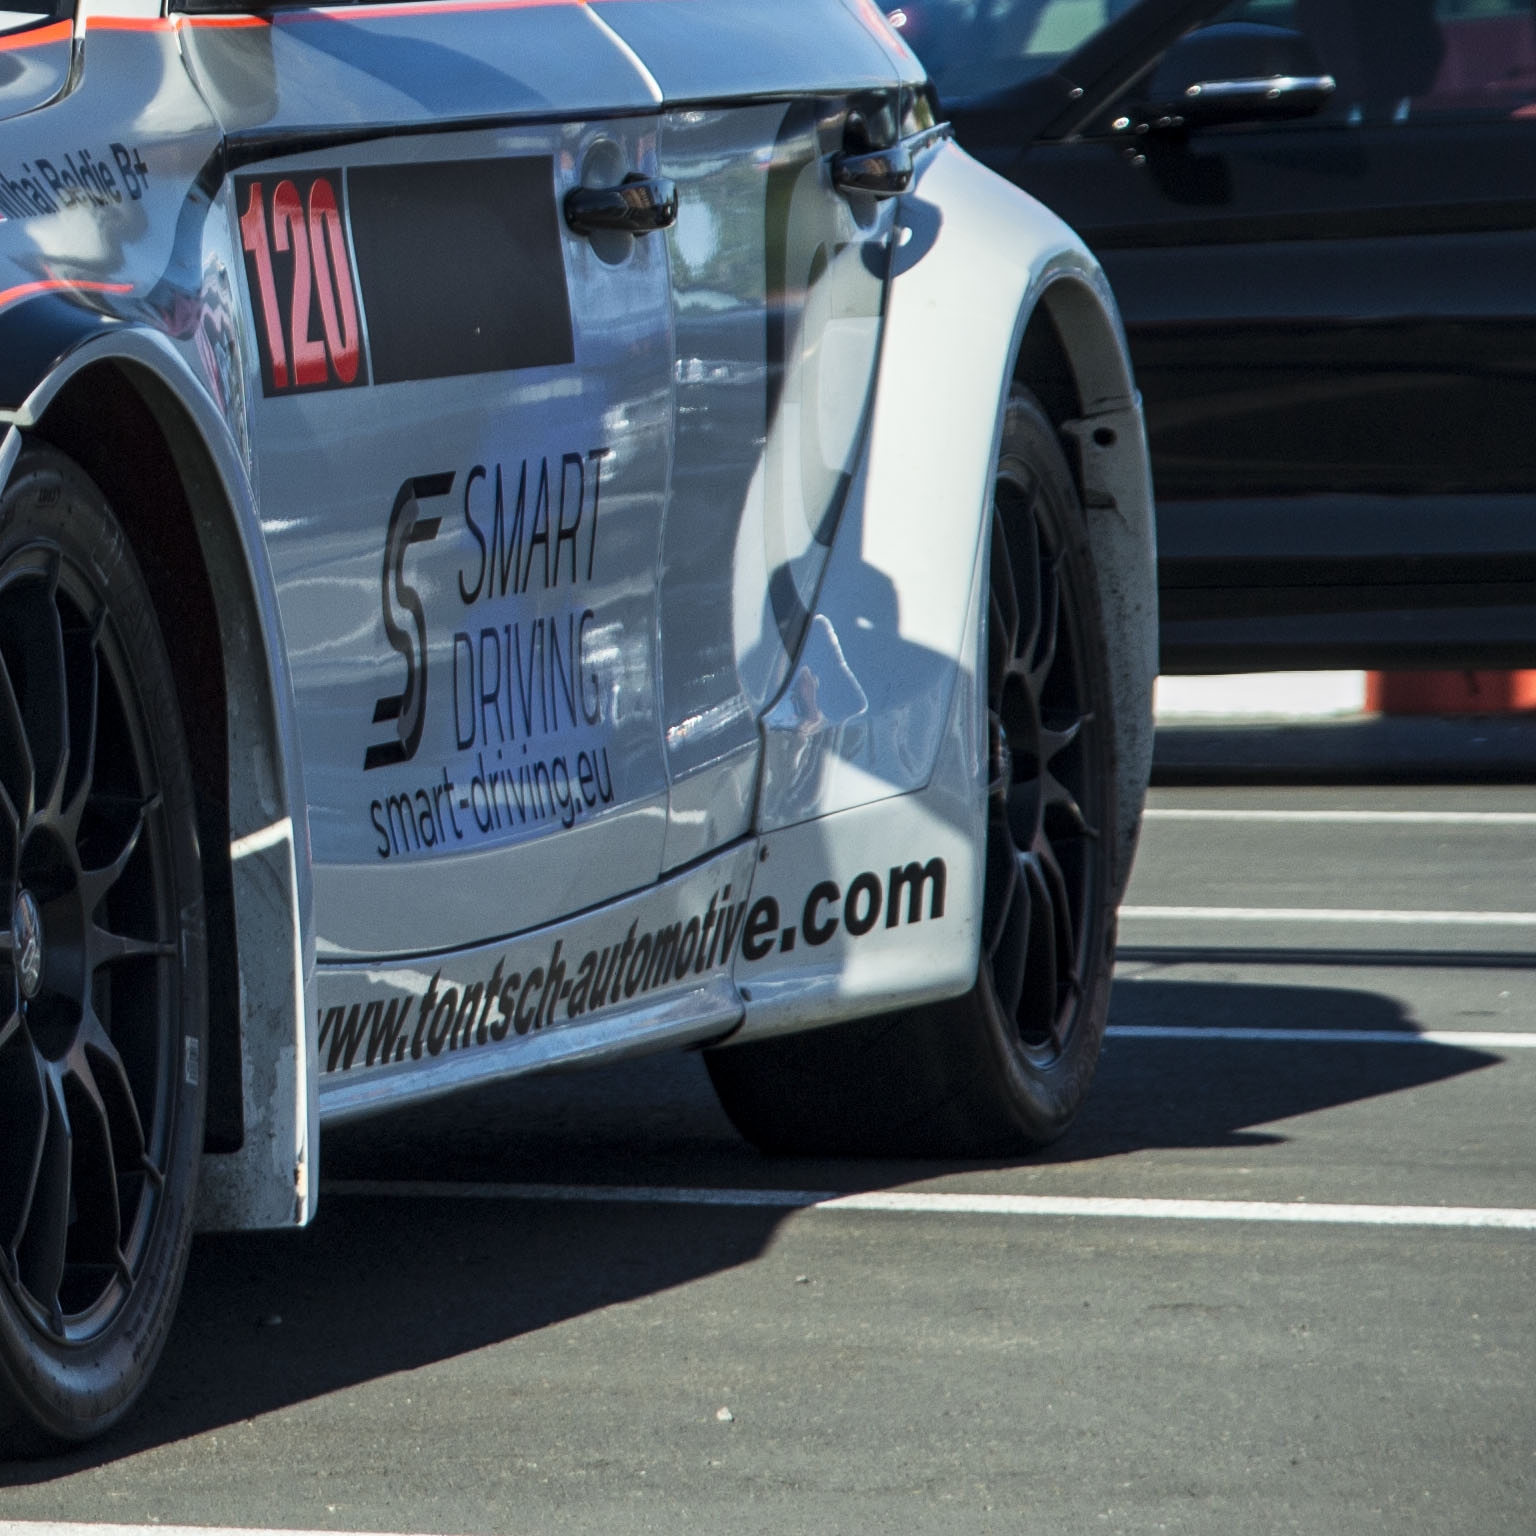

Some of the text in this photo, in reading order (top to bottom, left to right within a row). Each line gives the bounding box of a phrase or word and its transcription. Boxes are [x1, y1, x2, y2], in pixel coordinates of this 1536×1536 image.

[34, 148, 123, 208] Beldie
[240, 177, 360, 390] 120
[458, 447, 612, 606] SMART
[452, 609, 604, 753] DRIVING
[369, 745, 614, 860] smart-driving.eu
